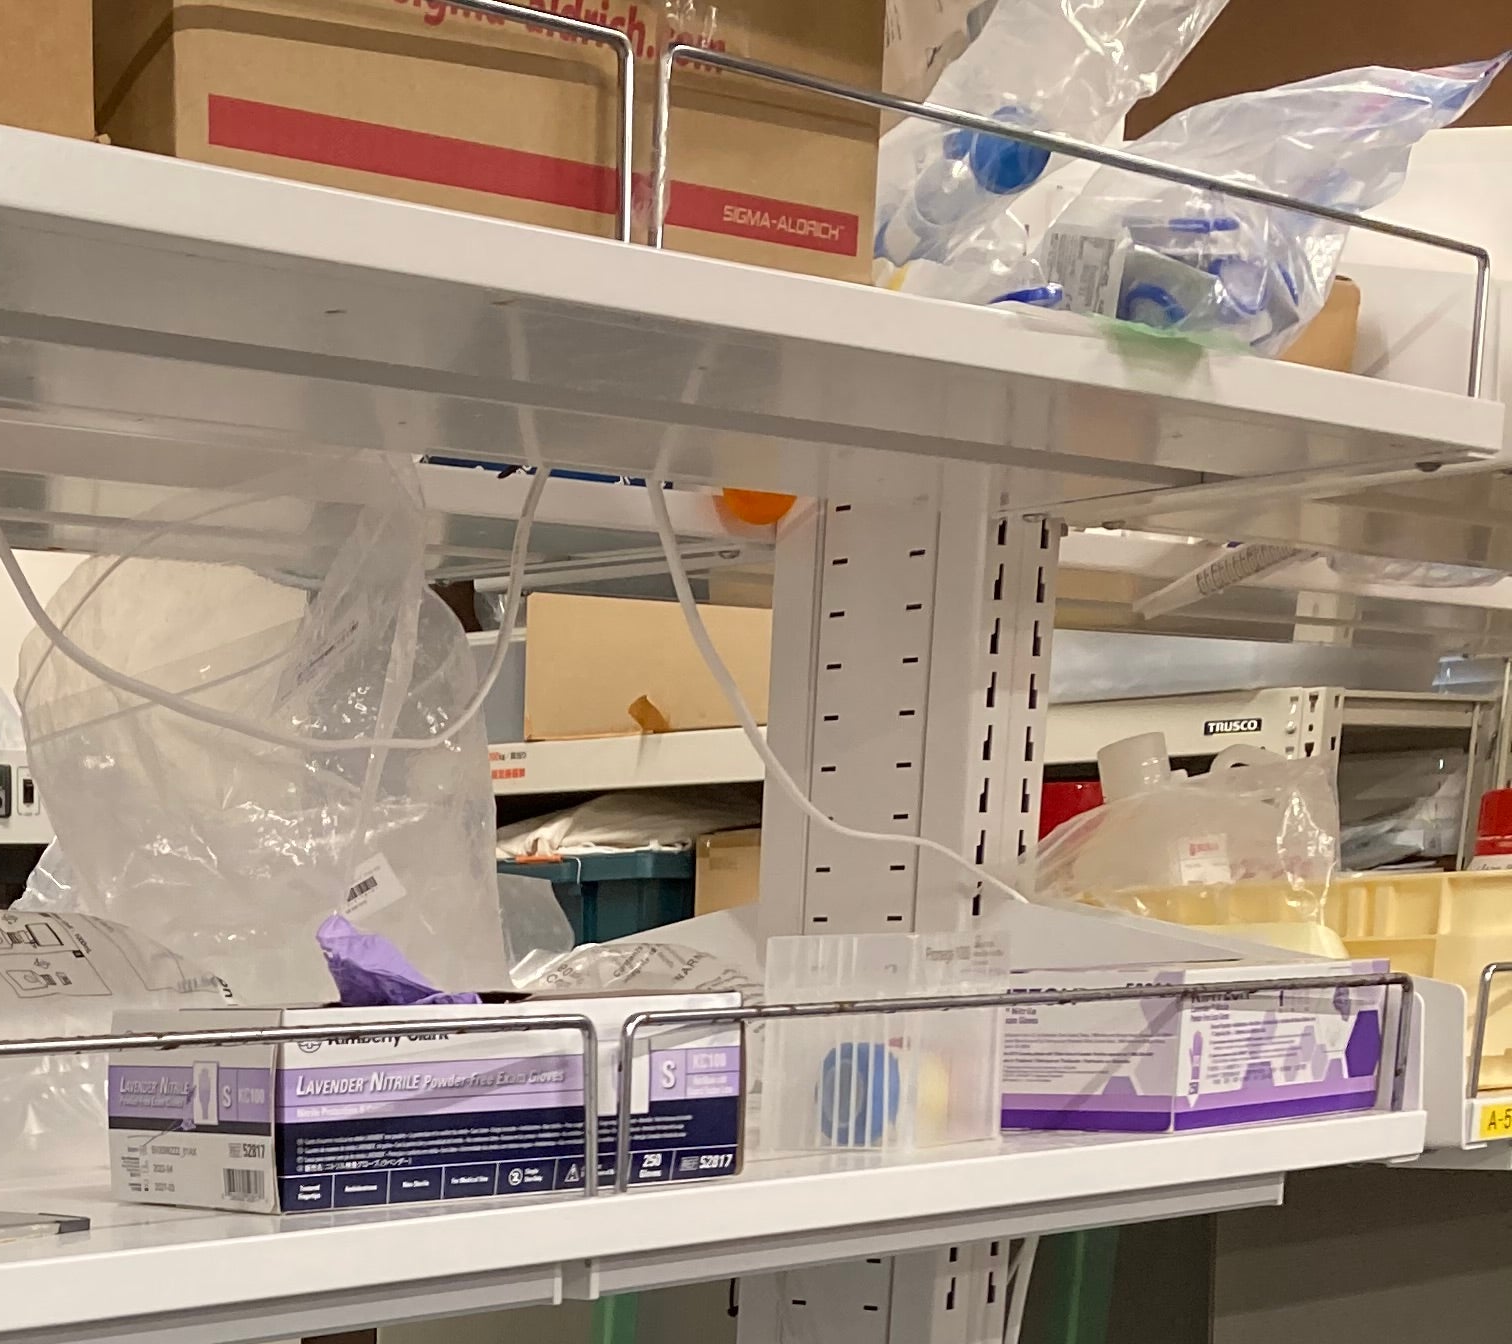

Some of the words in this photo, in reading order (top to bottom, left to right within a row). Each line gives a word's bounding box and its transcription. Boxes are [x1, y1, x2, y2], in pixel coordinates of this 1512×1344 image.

[1207, 719, 1258, 733] TRUSCO
[369, 1071, 420, 1093] NITRILE
[423, 1073, 494, 1089] Powder-Free
[496, 1071, 527, 1085] Exam
[528, 1069, 565, 1084] Gloves
[661, 1060, 677, 1089] S
[221, 1084, 233, 1109] S
[1486, 1108, 1512, 1131] A-5
[242, 1142, 266, 1159] 52817
[642, 1153, 662, 1168] 250
[699, 1153, 734, 1170] 52817
